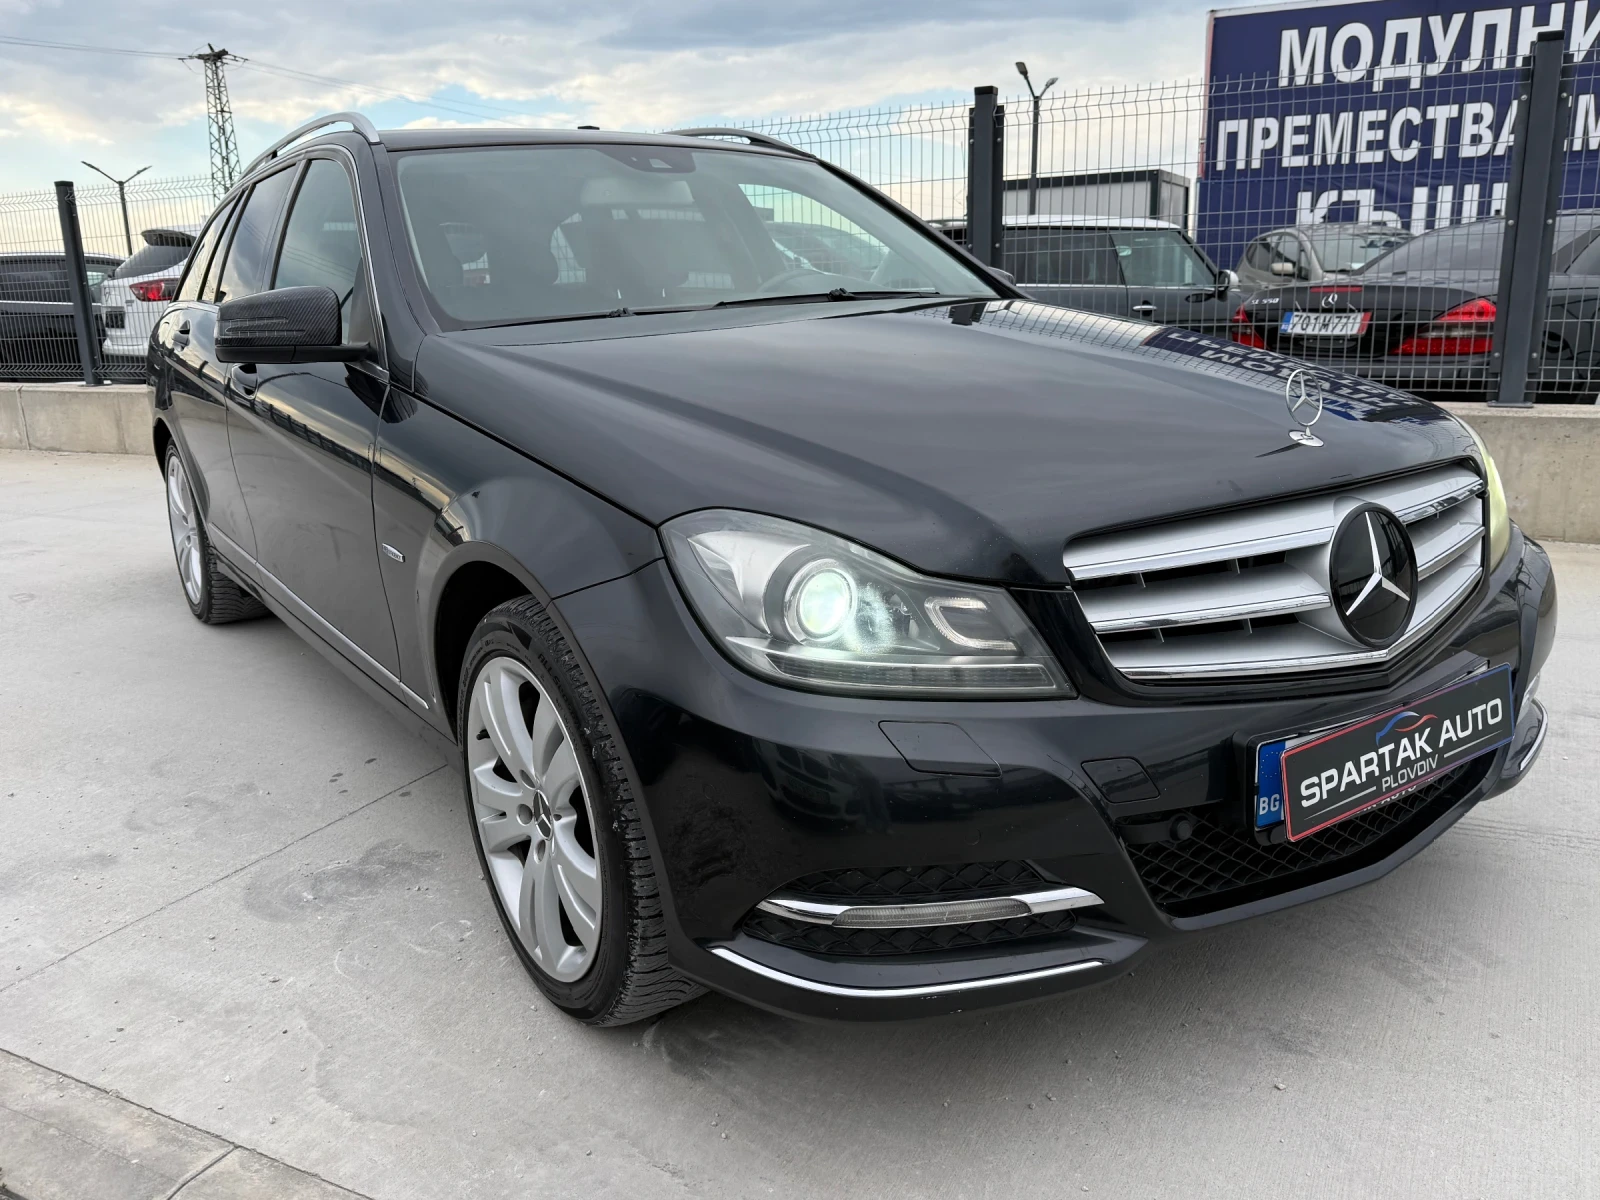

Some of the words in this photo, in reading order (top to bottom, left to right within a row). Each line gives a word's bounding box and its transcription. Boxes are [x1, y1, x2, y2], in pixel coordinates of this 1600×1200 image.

[1215, 94, 1600, 171] ПРЕМЕСТВАМ
[1300, 727, 1433, 808] SPARTAK
[1438, 697, 1503, 748] AUTO
[1381, 754, 1439, 793] PLOVDIV
[1258, 793, 1280, 816] BG
